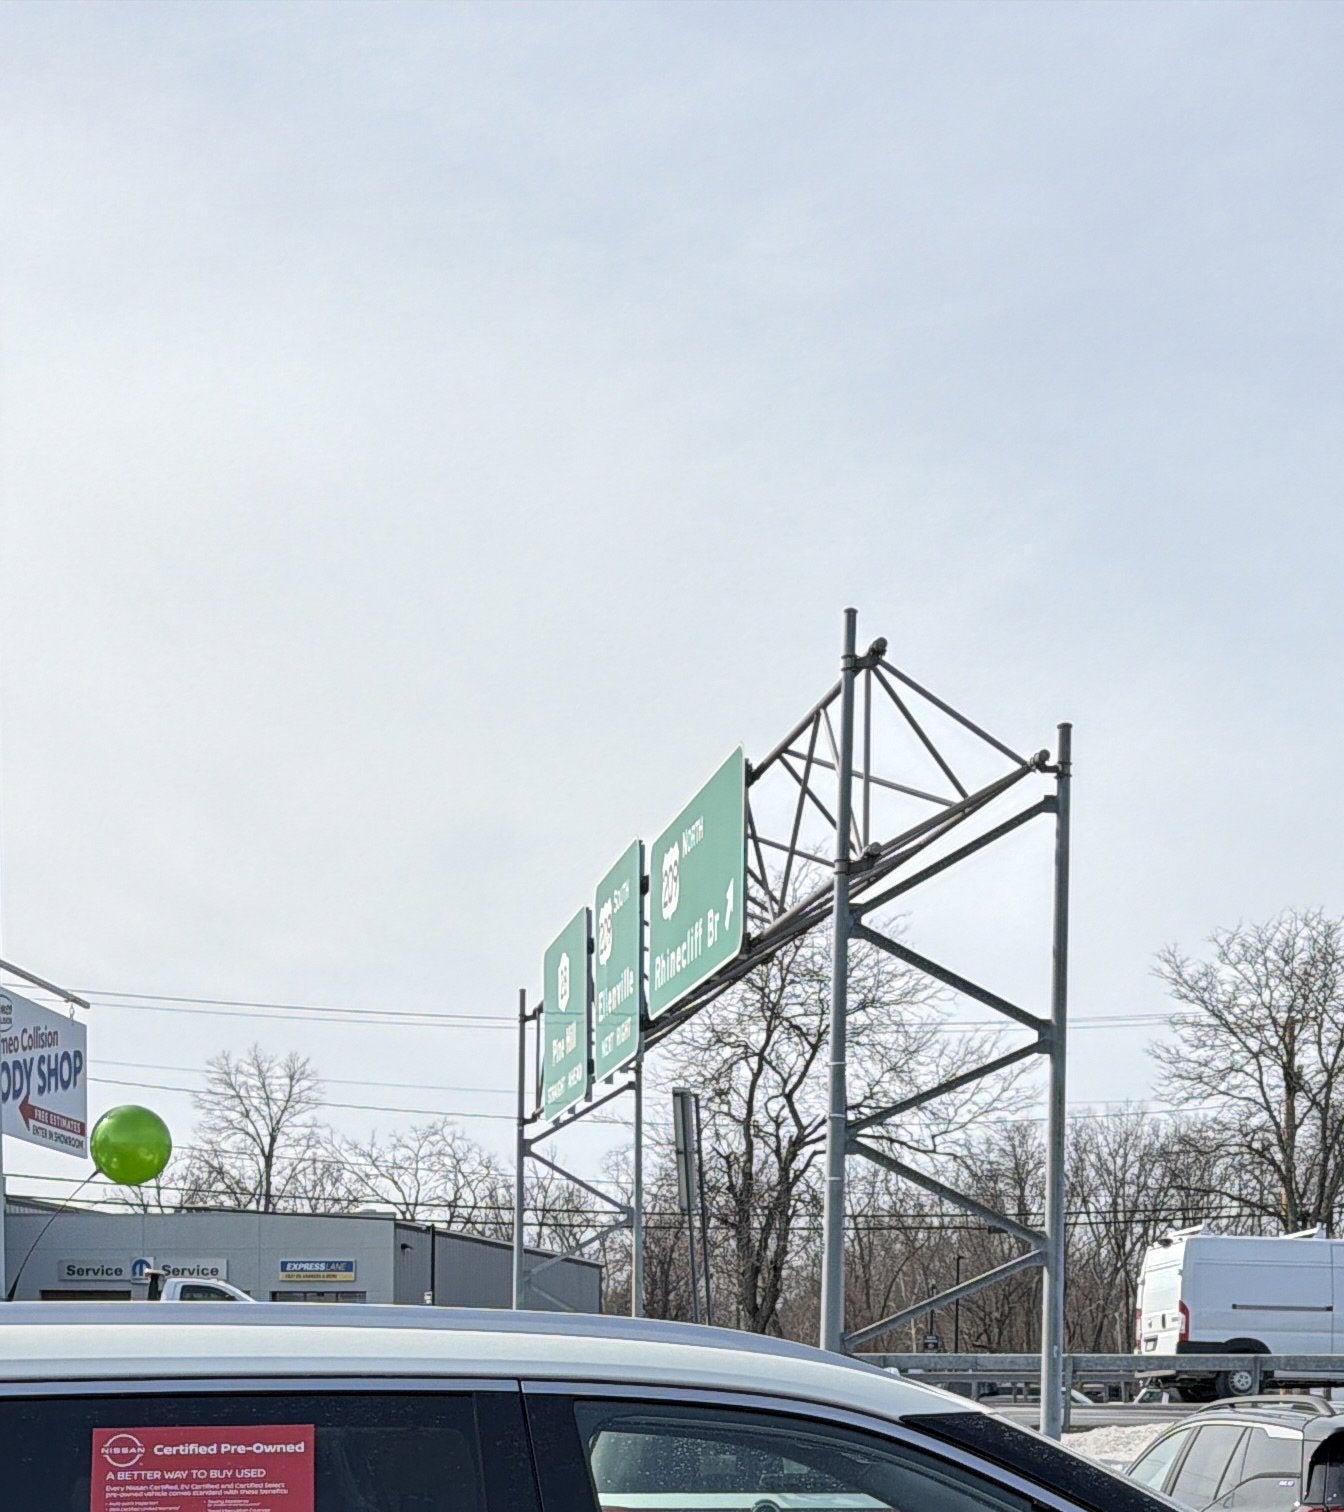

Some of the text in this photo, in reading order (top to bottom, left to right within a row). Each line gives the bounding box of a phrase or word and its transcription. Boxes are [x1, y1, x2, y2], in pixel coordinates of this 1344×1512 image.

[682, 815, 704, 858] NORTH
[663, 859, 679, 909] 209
[654, 908, 720, 991] Rhinecliff Br
[598, 966, 634, 1023] Ellenville
[21, 1025, 59, 1051] Collision
[1, 1050, 83, 1104] ODY SHOP
[34, 1108, 81, 1134] FREE ESTIMATES
[32, 1124, 47, 1138] ENTER
[54, 1131, 84, 1149] SHOWROOM
[66, 1264, 219, 1277] Service Service
[286, 1262, 326, 1271] EXPRESS
[101, 1446, 145, 1455] NISSAN
[153, 1441, 305, 1456] Certified Pre-Owned
[106, 1468, 267, 1480] A BETTER WAY TO BUY USED
[105, 1484, 124, 1492] Every
